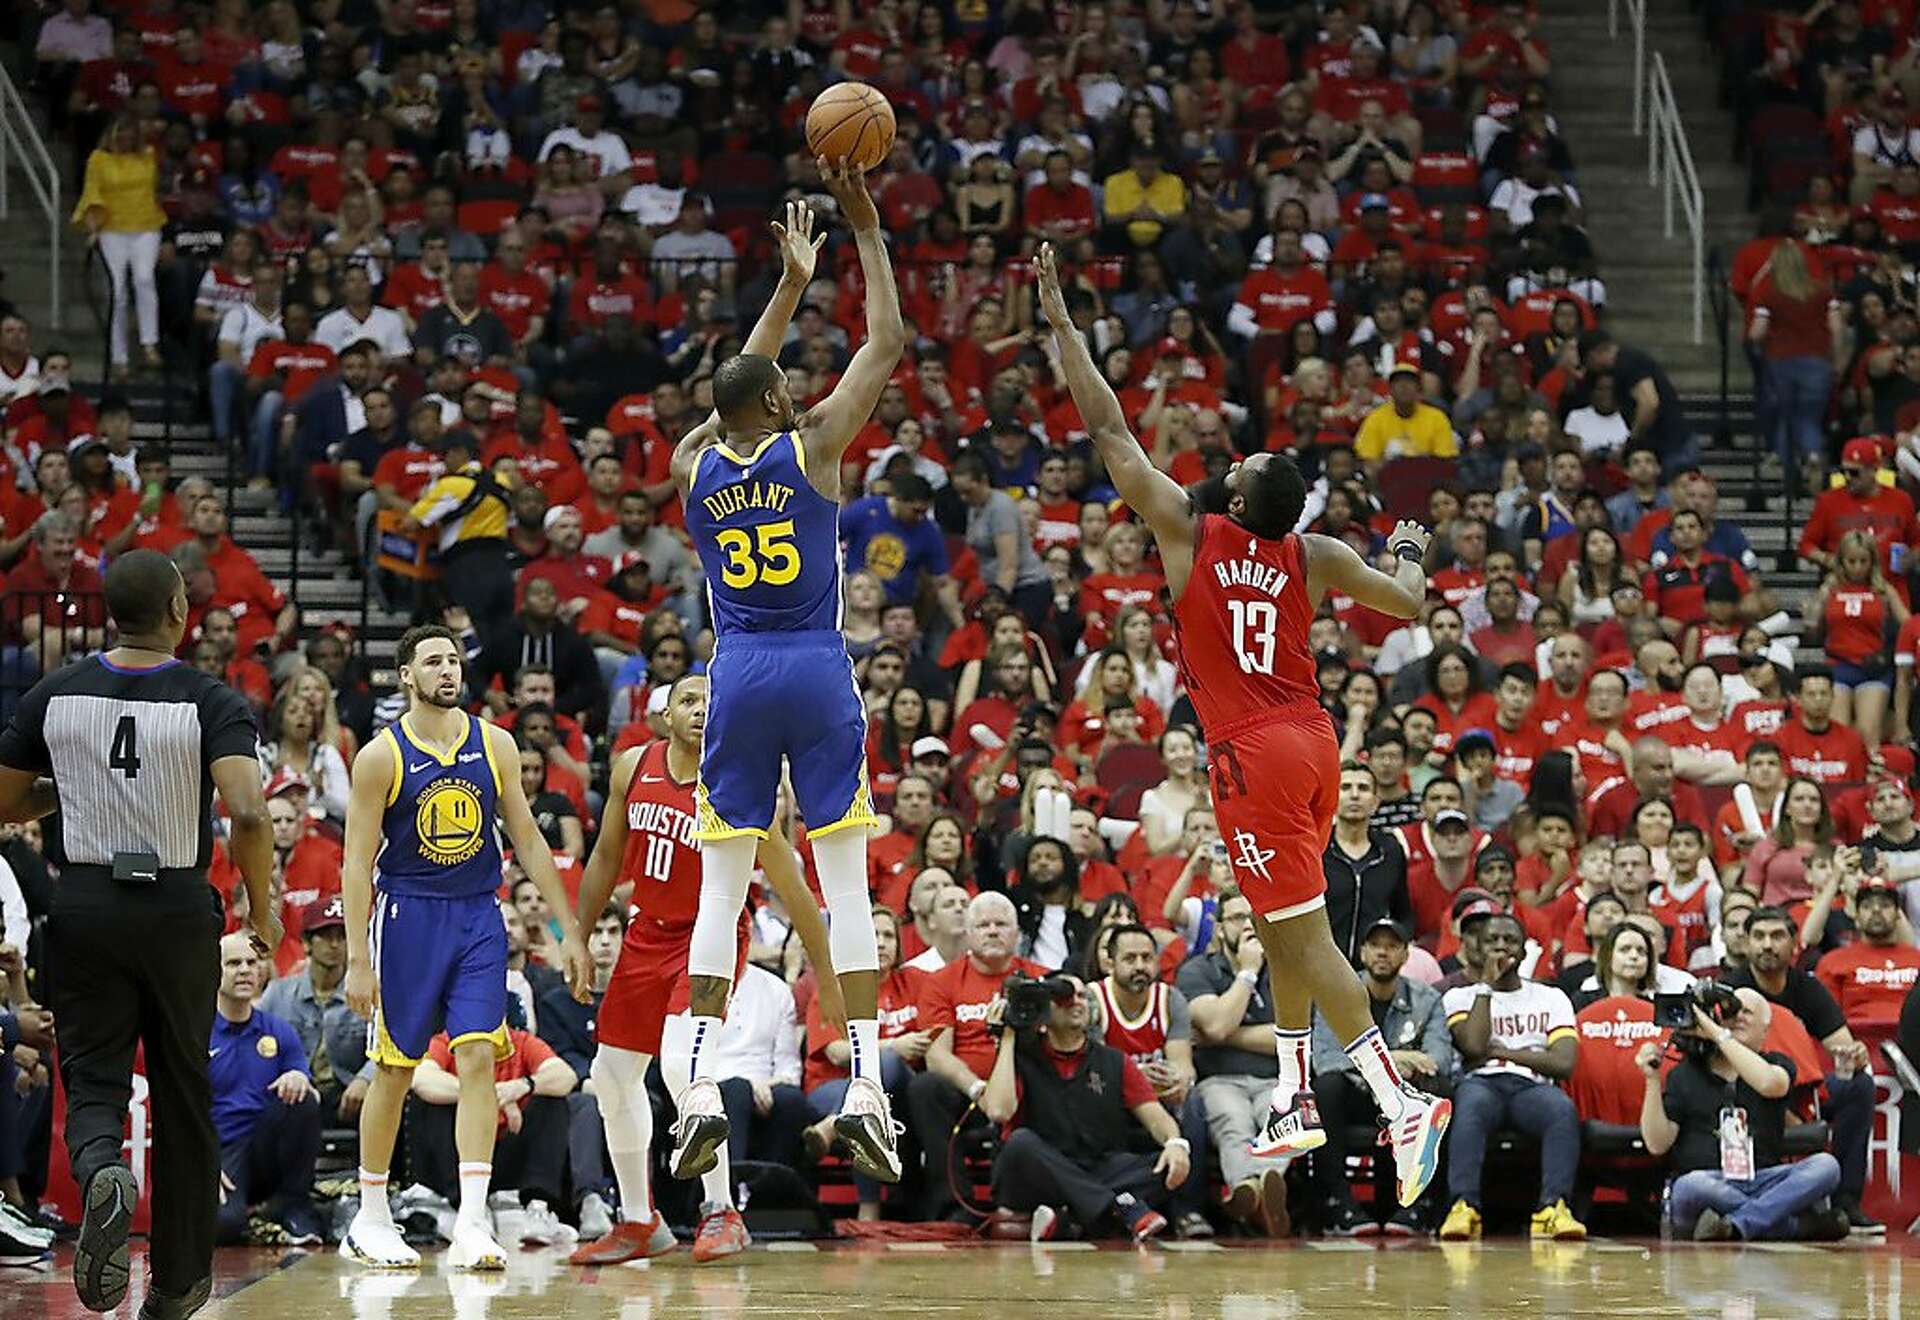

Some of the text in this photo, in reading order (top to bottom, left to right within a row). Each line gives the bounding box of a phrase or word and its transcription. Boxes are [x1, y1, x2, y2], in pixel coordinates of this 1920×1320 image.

[703, 479, 795, 523] DURANT
[714, 517, 802, 591] 35
[1213, 559, 1290, 598] HARDEN
[1226, 599, 1278, 677] 13
[109, 715, 142, 779] 4
[415, 777, 483, 805] GOLDEN STATE
[453, 800, 467, 818] 11
[417, 836, 486, 866] WARRIORS
[643, 833, 675, 883] 10
[1492, 1011, 1551, 1039] uston
